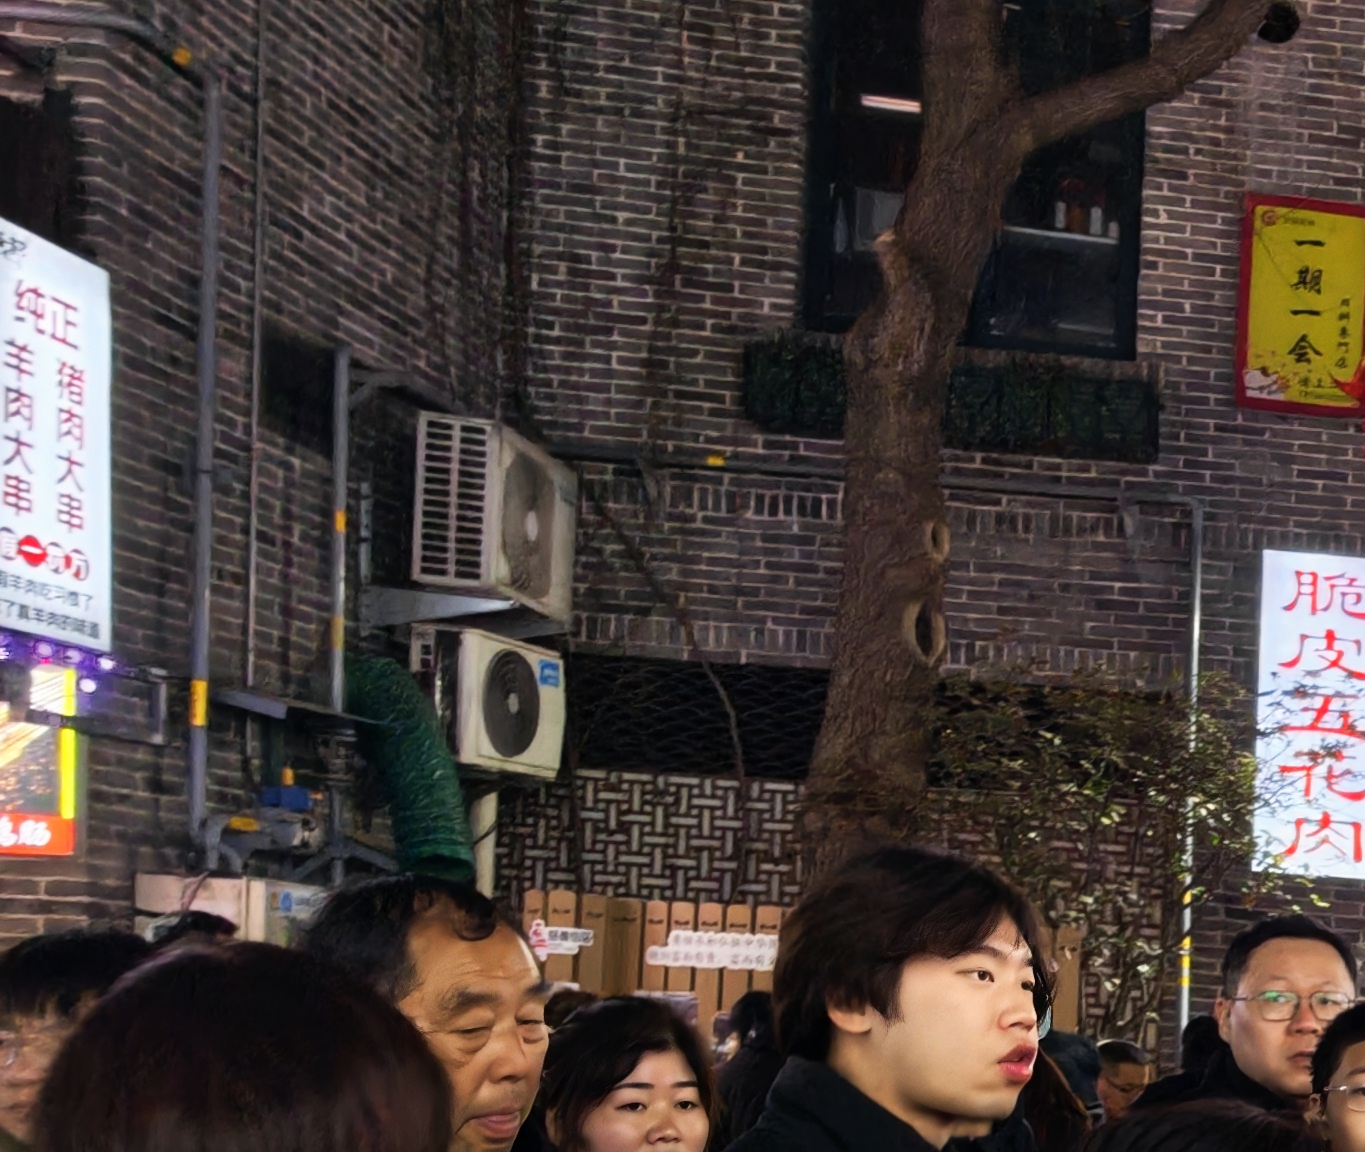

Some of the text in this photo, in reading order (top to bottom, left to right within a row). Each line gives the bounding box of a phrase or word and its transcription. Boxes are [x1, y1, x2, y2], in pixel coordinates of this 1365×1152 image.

[14, 279, 79, 350] 纯正
[1287, 239, 1326, 365] 一期一会
[3, 338, 35, 516] 羊肉大串
[56, 361, 85, 532] 猪肉大串
